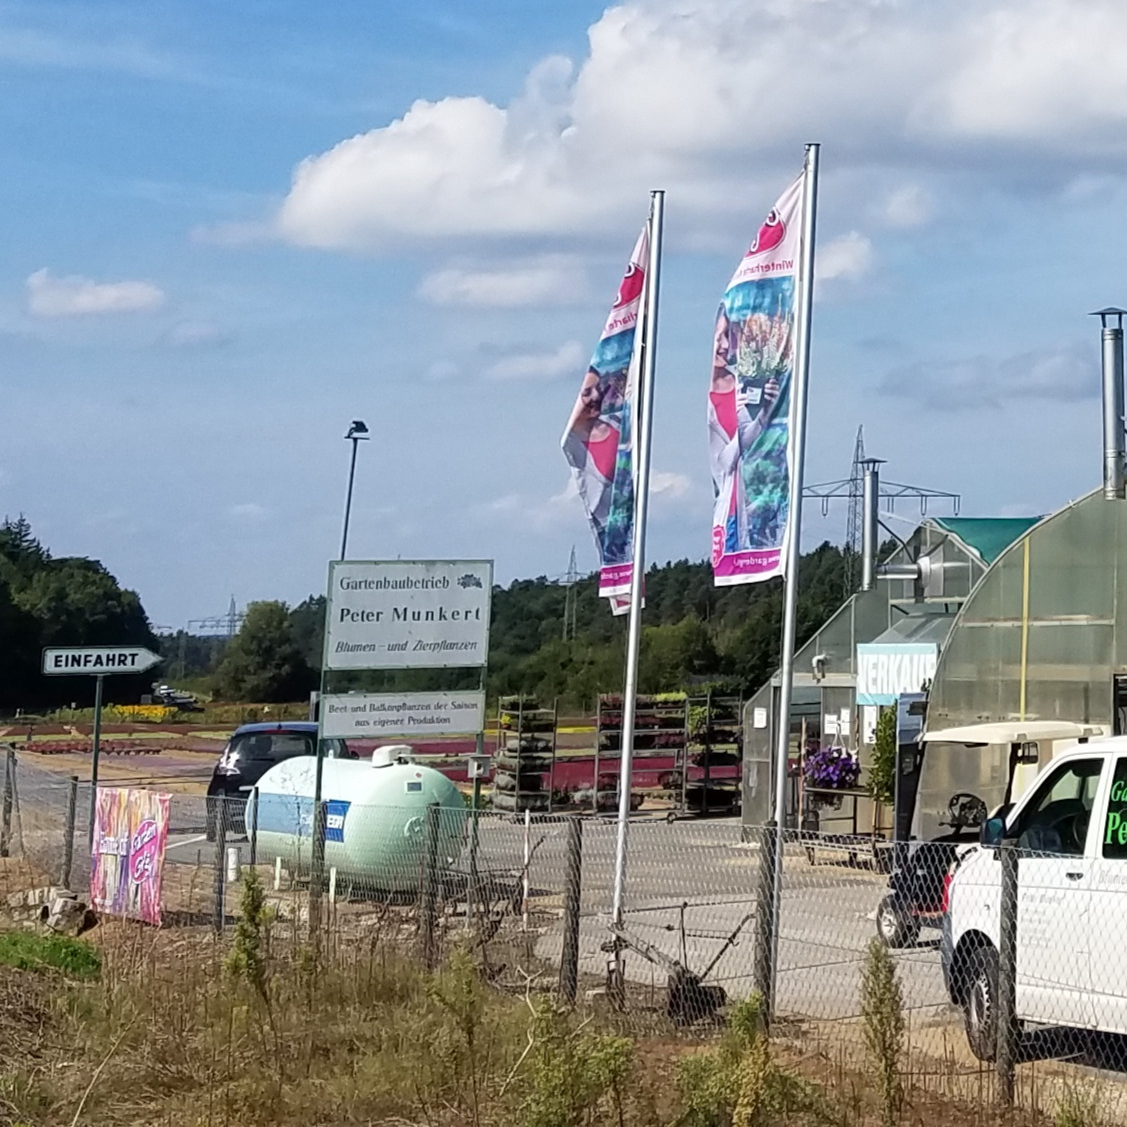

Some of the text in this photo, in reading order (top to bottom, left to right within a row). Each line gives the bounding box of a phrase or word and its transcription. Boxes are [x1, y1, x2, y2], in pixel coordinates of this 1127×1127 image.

[339, 575, 450, 591] Gartenbaubetrieb
[340, 606, 481, 623] Peter Munkert
[412, 639, 478, 653] Zierpflanzen
[53, 653, 139, 668] EINFAHRT
[328, 704, 347, 714] Beet
[350, 704, 366, 713] und
[434, 701, 448, 711] der
[451, 701, 478, 711] Saison
[355, 715, 451, 728] aus eigener Produktion
